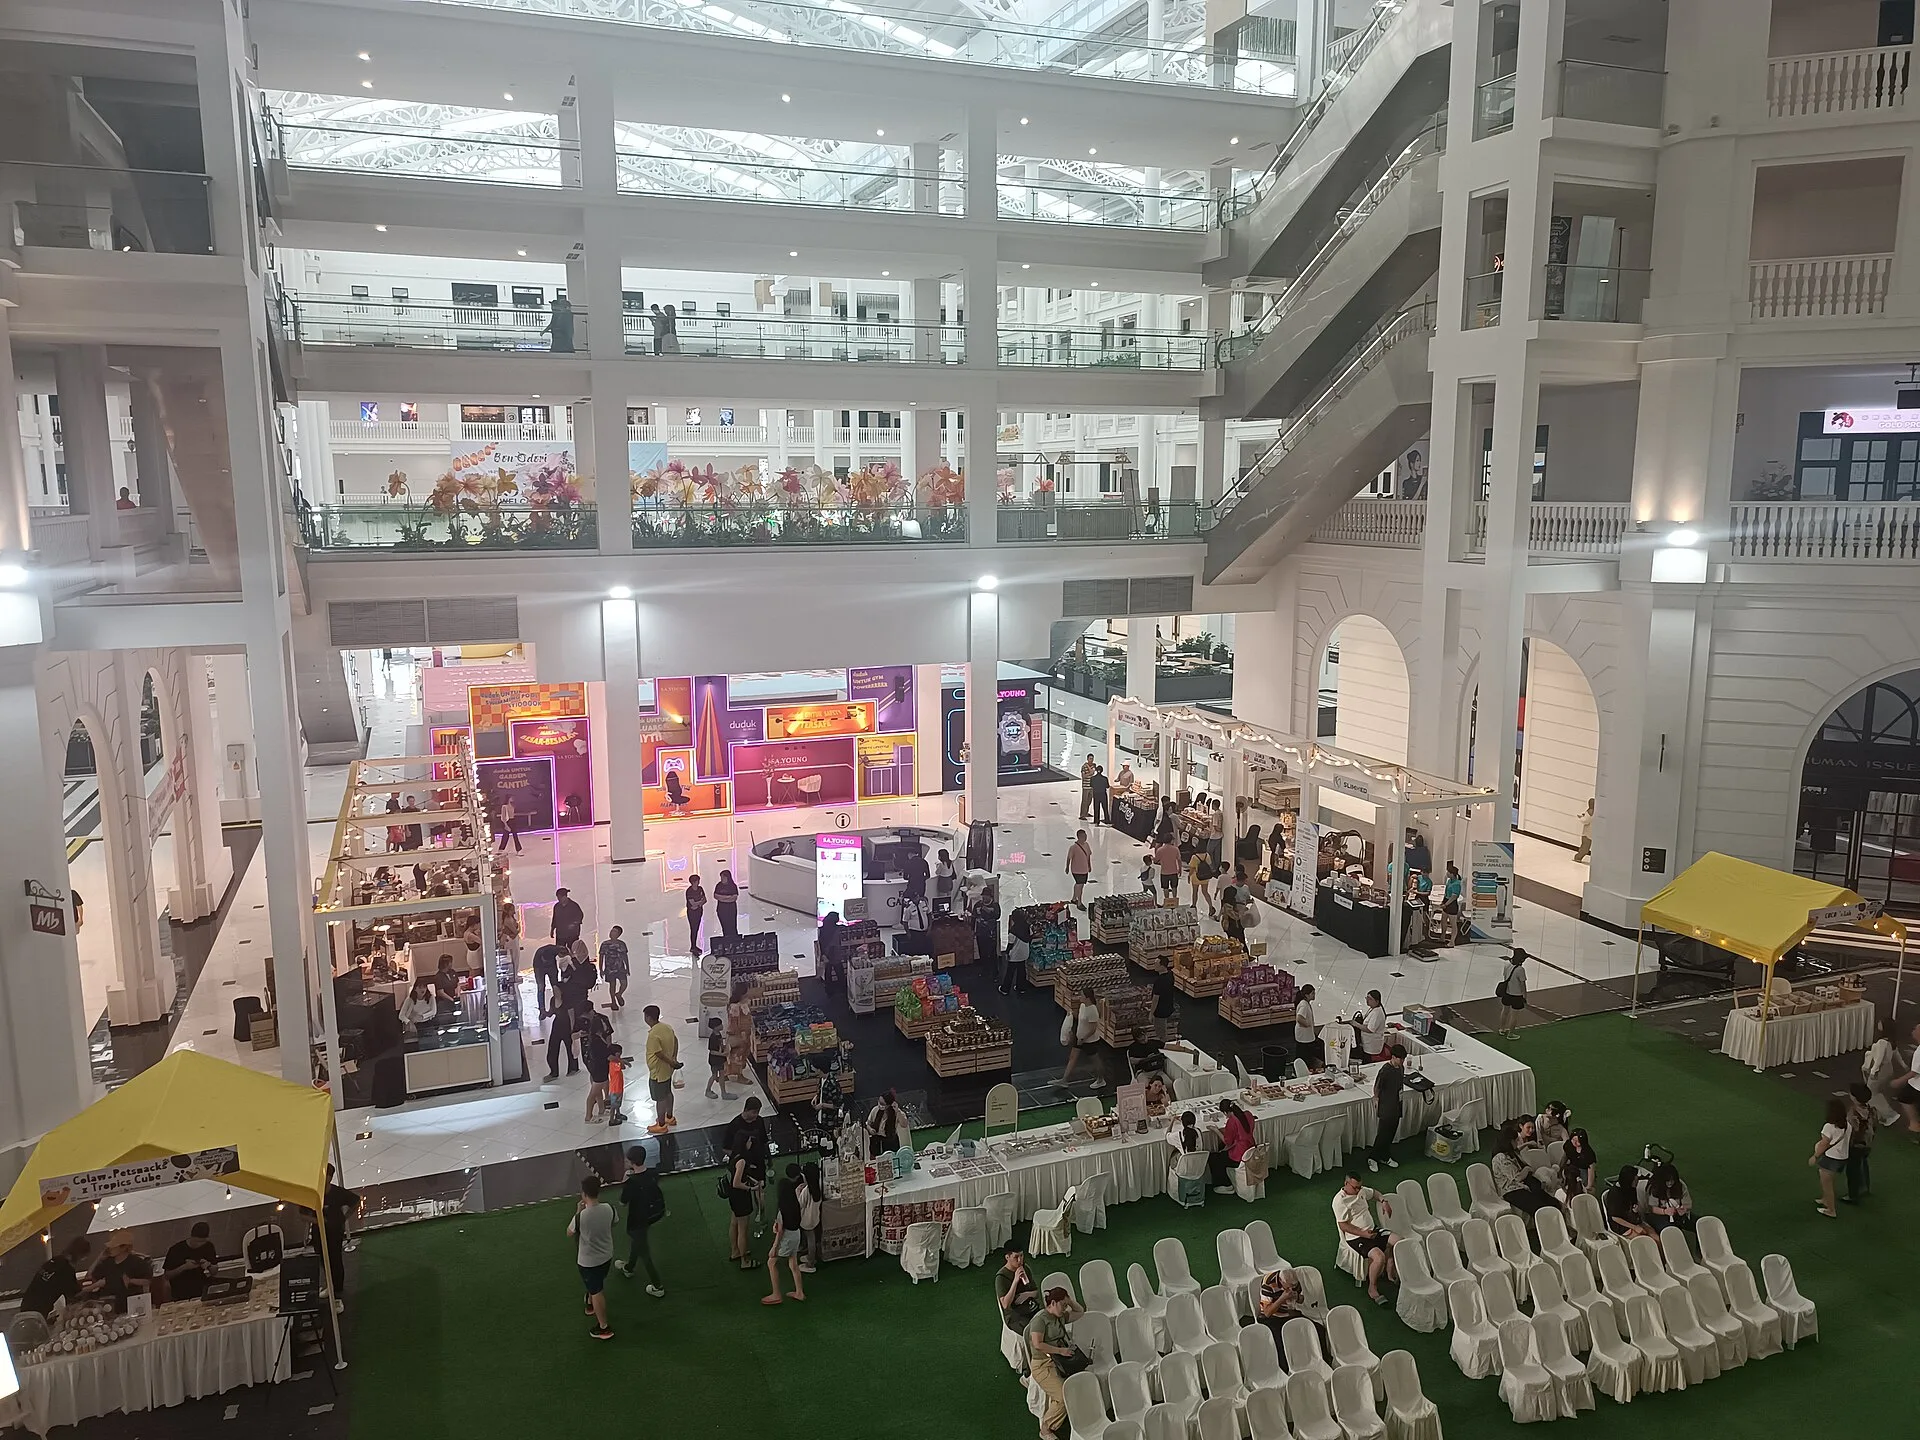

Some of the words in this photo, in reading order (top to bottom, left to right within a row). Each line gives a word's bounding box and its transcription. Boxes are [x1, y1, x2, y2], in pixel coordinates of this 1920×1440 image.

[1879, 421, 1903, 429] GOLD
[729, 719, 757, 729] duduk
[497, 779, 530, 789] CANTIK
[72, 1161, 169, 1186] Colaw.Petsnacks
[91, 1178, 132, 1192] Tropics
[134, 1173, 162, 1185] Cube
